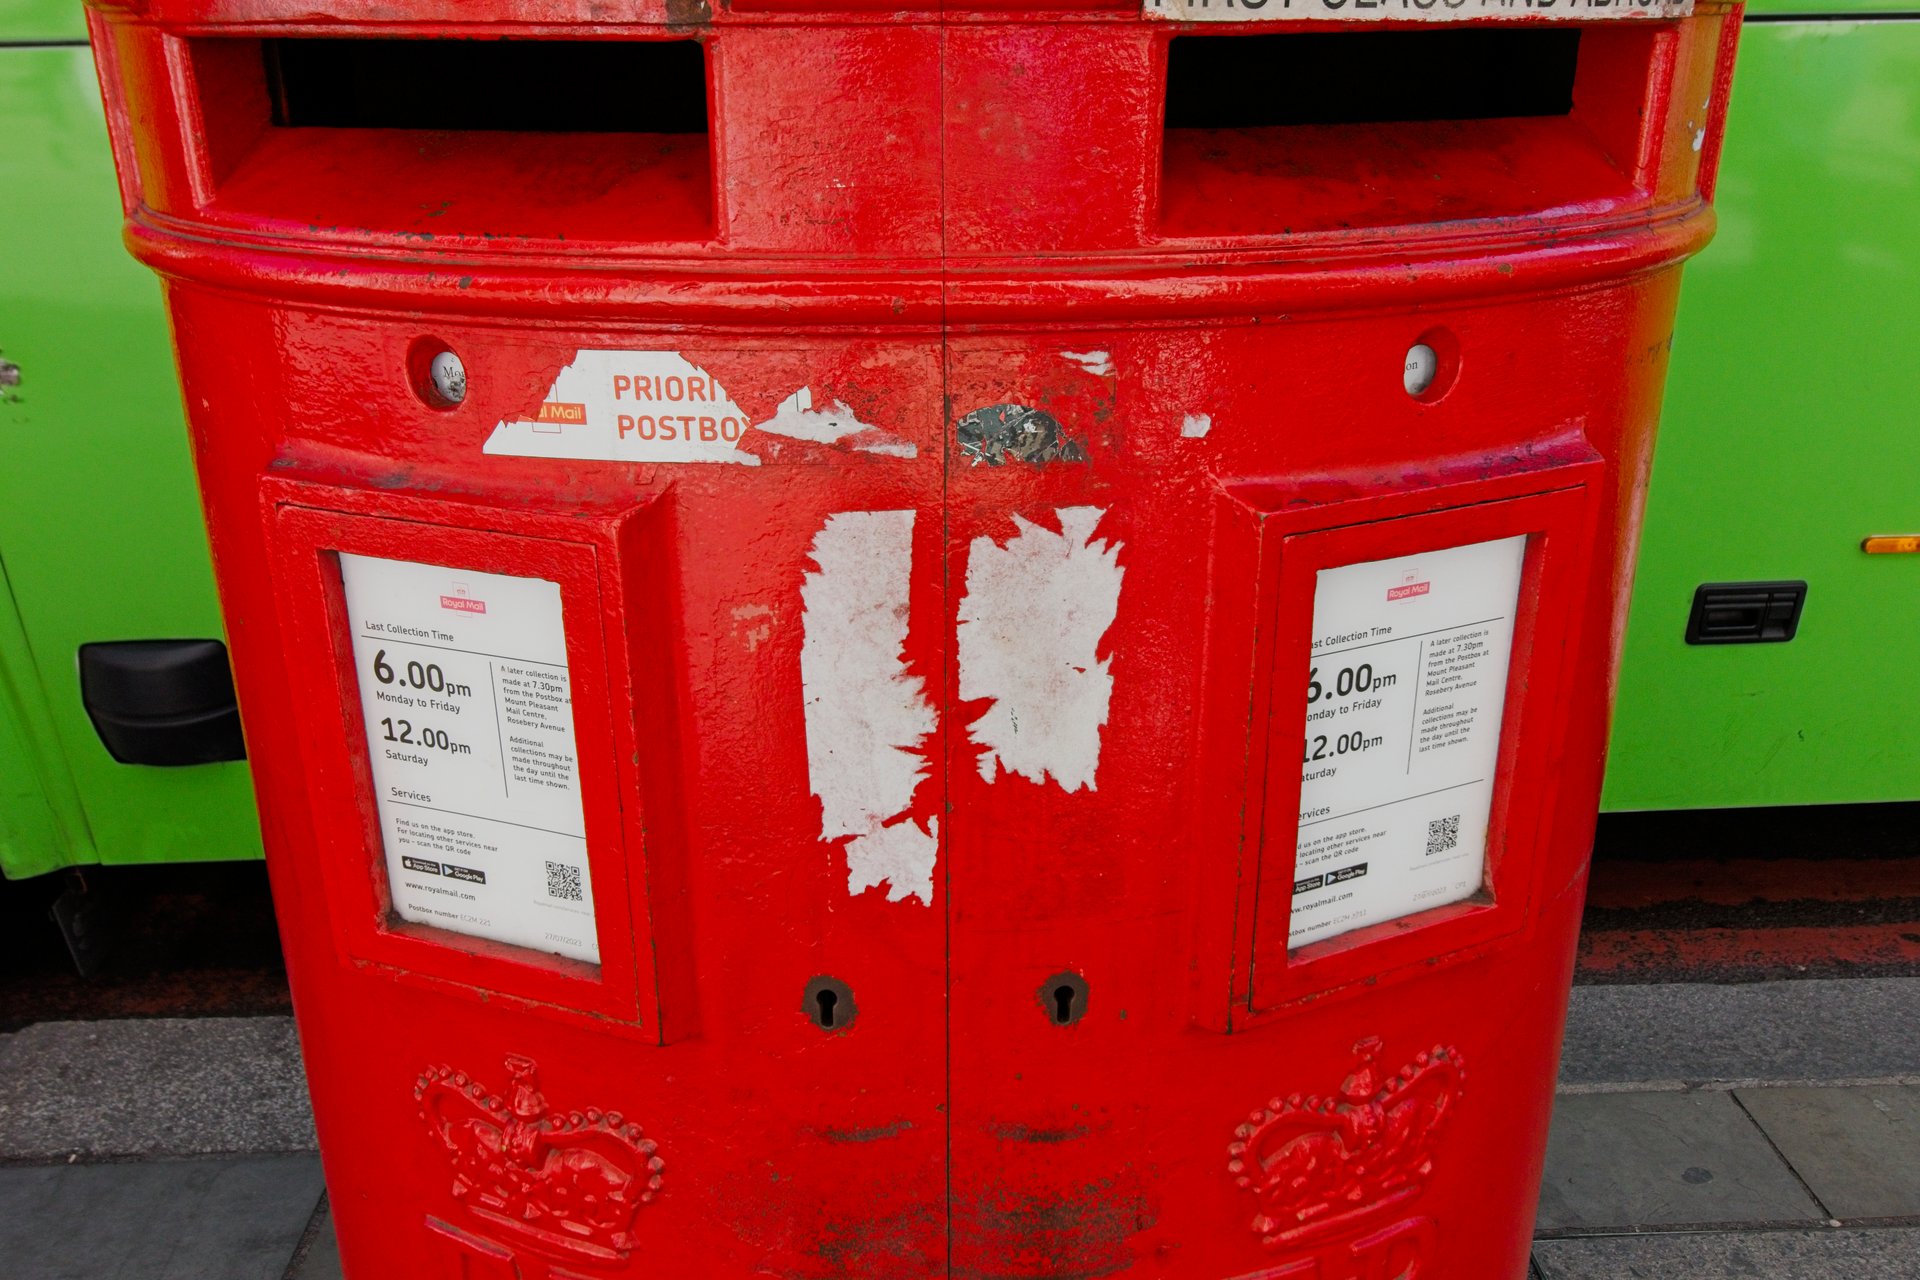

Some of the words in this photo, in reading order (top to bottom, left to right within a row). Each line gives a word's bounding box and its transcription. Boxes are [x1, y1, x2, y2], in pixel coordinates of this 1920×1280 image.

[613, 375, 733, 402] PRIORI
[551, 405, 581, 419] Mail
[617, 414, 751, 441] POSTBO
[1389, 587, 1410, 598] Royal
[1411, 583, 1428, 593] Mail
[442, 598, 464, 608] Royal
[466, 600, 484, 611] Mail
[366, 620, 384, 631] Last
[387, 623, 429, 638] Collection
[431, 629, 454, 642] Time
[1326, 631, 1368, 646] Collection
[1370, 626, 1392, 637] Time
[1453, 631, 1482, 642] collection
[1429, 650, 1446, 658] made
[1457, 641, 1484, 652] 7.30pm
[1457, 652, 1480, 661] Postbox
[374, 649, 472, 698] 6.00pm
[507, 667, 523, 675] later
[526, 670, 559, 680] collection
[1427, 668, 1447, 677] Mount
[1449, 662, 1475, 672] Pleasant
[502, 678, 521, 686] made
[532, 680, 563, 693] 7.30pm
[1426, 679, 1439, 687] Mail
[1455, 681, 1477, 689] Avenue
[503, 687, 520, 695] from
[522, 690, 533, 698] the
[536, 692, 563, 702] Postbox
[376, 691, 414, 707] Monday
[417, 699, 427, 707] to
[430, 699, 460, 714] Friday
[505, 697, 527, 706] Mount
[528, 700, 558, 712] Pleasant
[1307, 709, 1336, 721] onday
[1352, 699, 1382, 711] Friday
[1423, 702, 1454, 715] Additional
[506, 707, 520, 715] Mail
[507, 716, 538, 728] Rosebery
[540, 722, 565, 732] Avenue
[1421, 726, 1437, 734] made
[1440, 717, 1473, 729] throughout
[1422, 713, 1454, 725] collections
[381, 717, 471, 754] 12.00pm
[1445, 729, 1458, 737] until
[510, 736, 544, 747] Additional
[385, 749, 428, 766] Saturday
[510, 746, 546, 757] collections
[548, 753, 562, 761] may
[512, 756, 530, 764] made
[533, 760, 571, 771] throughout
[526, 767, 538, 775] day
[514, 774, 527, 782] last
[529, 776, 544, 785] time
[1302, 767, 1337, 781] aturday
[391, 787, 431, 802] Services
[396, 818, 409, 826] Find
[409, 828, 434, 841] locating
[436, 834, 453, 843] other
[455, 839, 481, 849] services
[417, 840, 431, 848] scan
[1300, 848, 1325, 858] locating
[1327, 842, 1343, 850] other
[1346, 835, 1370, 845] services
[1372, 830, 1387, 838] near
[1345, 847, 1359, 855] code
[405, 881, 476, 901] www.royalmail.com
[408, 903, 432, 914] Postbox
[435, 910, 459, 919] number
[1307, 920, 1332, 931] number
